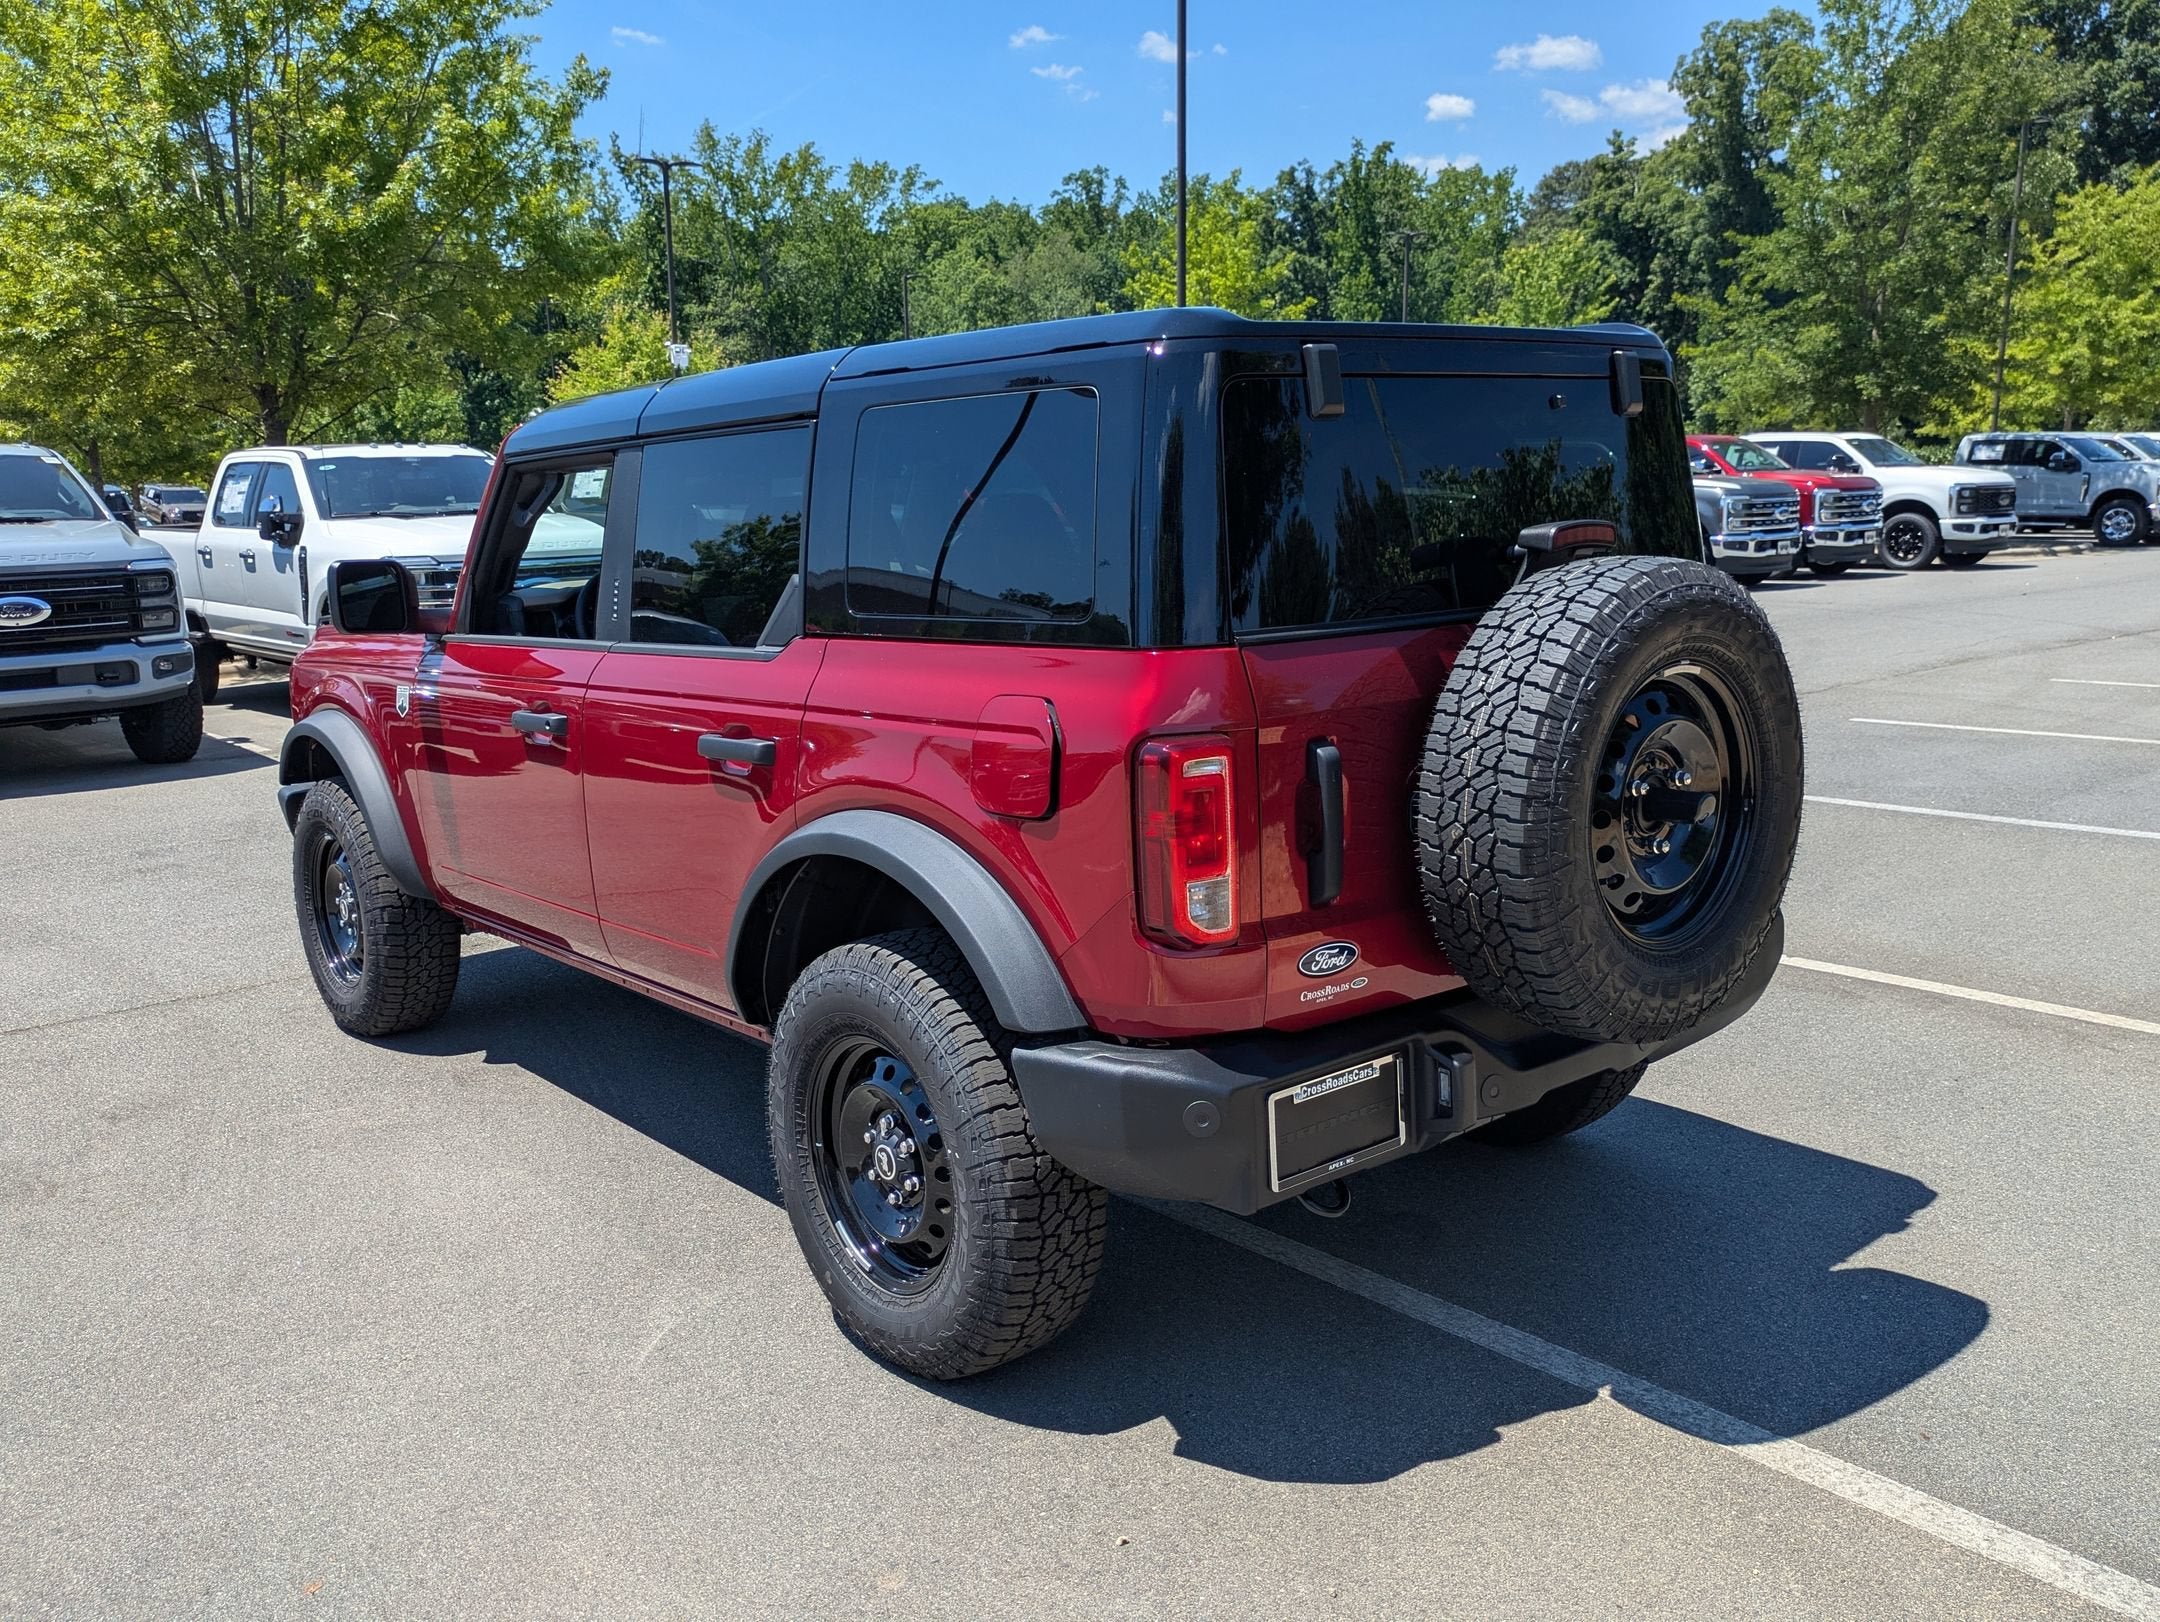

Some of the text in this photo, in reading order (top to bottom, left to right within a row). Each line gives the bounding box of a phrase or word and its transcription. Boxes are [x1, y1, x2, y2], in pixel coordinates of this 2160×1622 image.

[20, 551, 97, 563] DUTY
[0, 604, 33, 619] Ford
[1311, 947, 1348, 971] Ford
[1301, 1067, 1373, 1098] CrossRoadsCars
